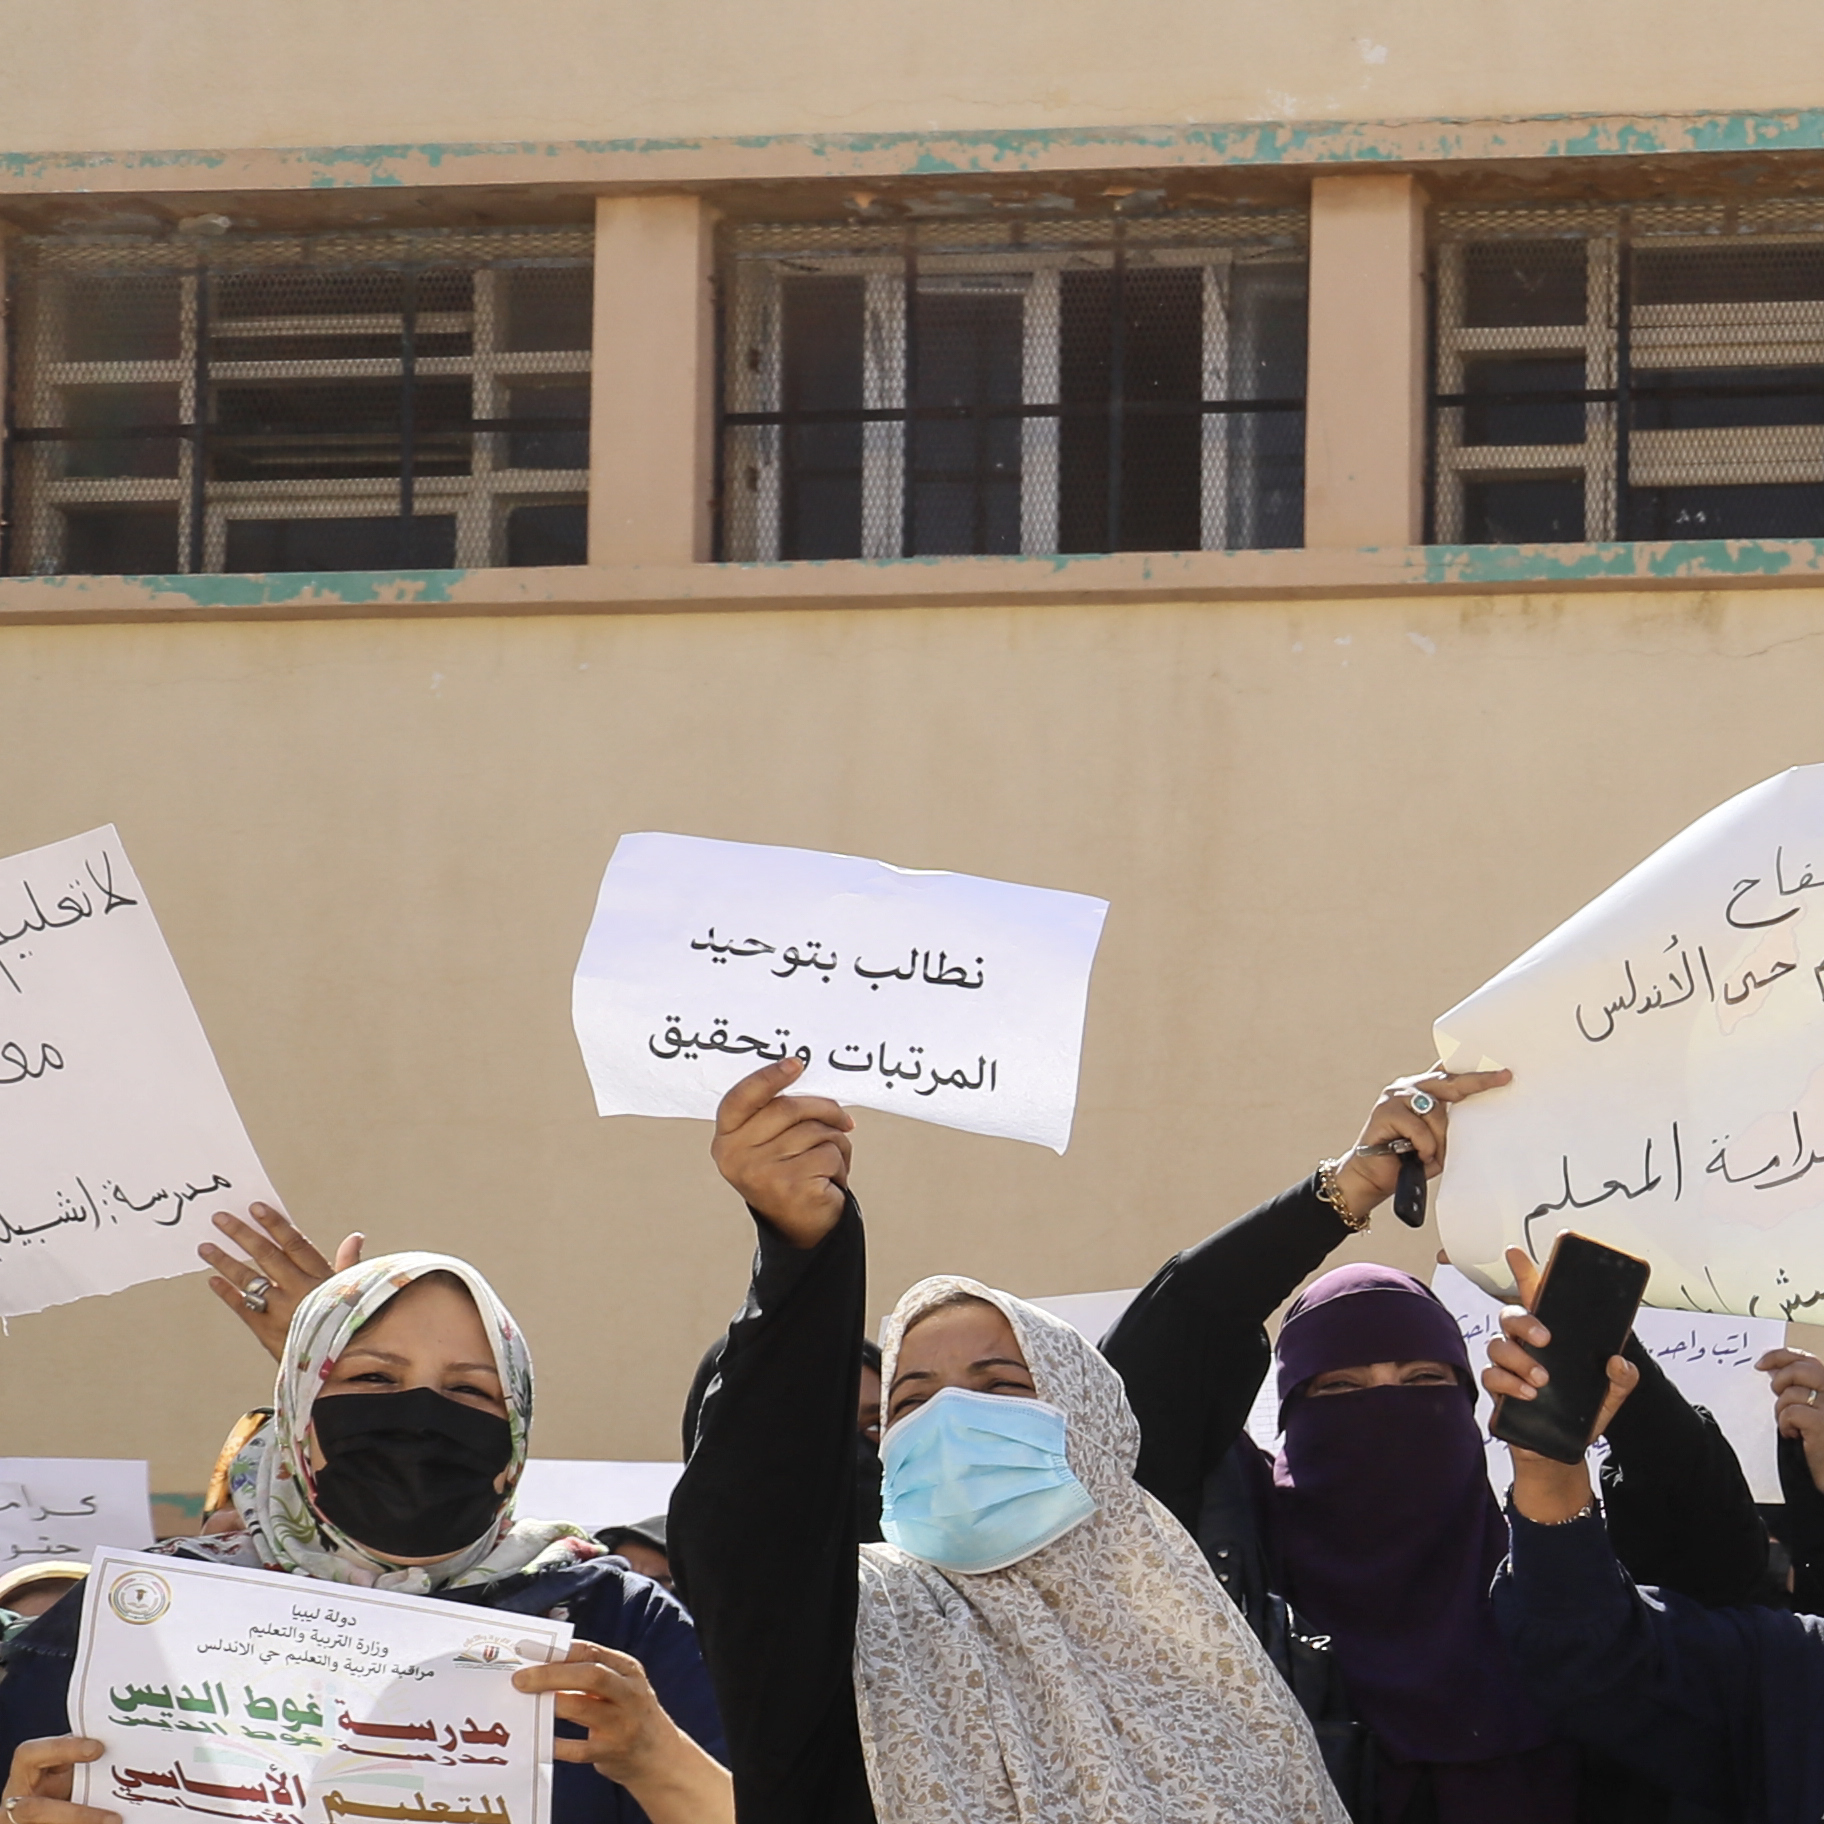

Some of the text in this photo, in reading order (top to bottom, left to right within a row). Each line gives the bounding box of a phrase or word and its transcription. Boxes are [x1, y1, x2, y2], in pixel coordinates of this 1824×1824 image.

[690, 927, 984, 991] نطالب بتوحيد
[648, 1012, 997, 1096] المرتبات وتحقيق
[1524, 1121, 1682, 1265] المعلم
[249, 1623, 389, 1658] وزارة التربية والتعليم
[292, 1604, 356, 1628] دولة ليبيا
[110, 1680, 511, 1752] مدرسة غوط الديس
[111, 1760, 306, 1809] الأساسي
